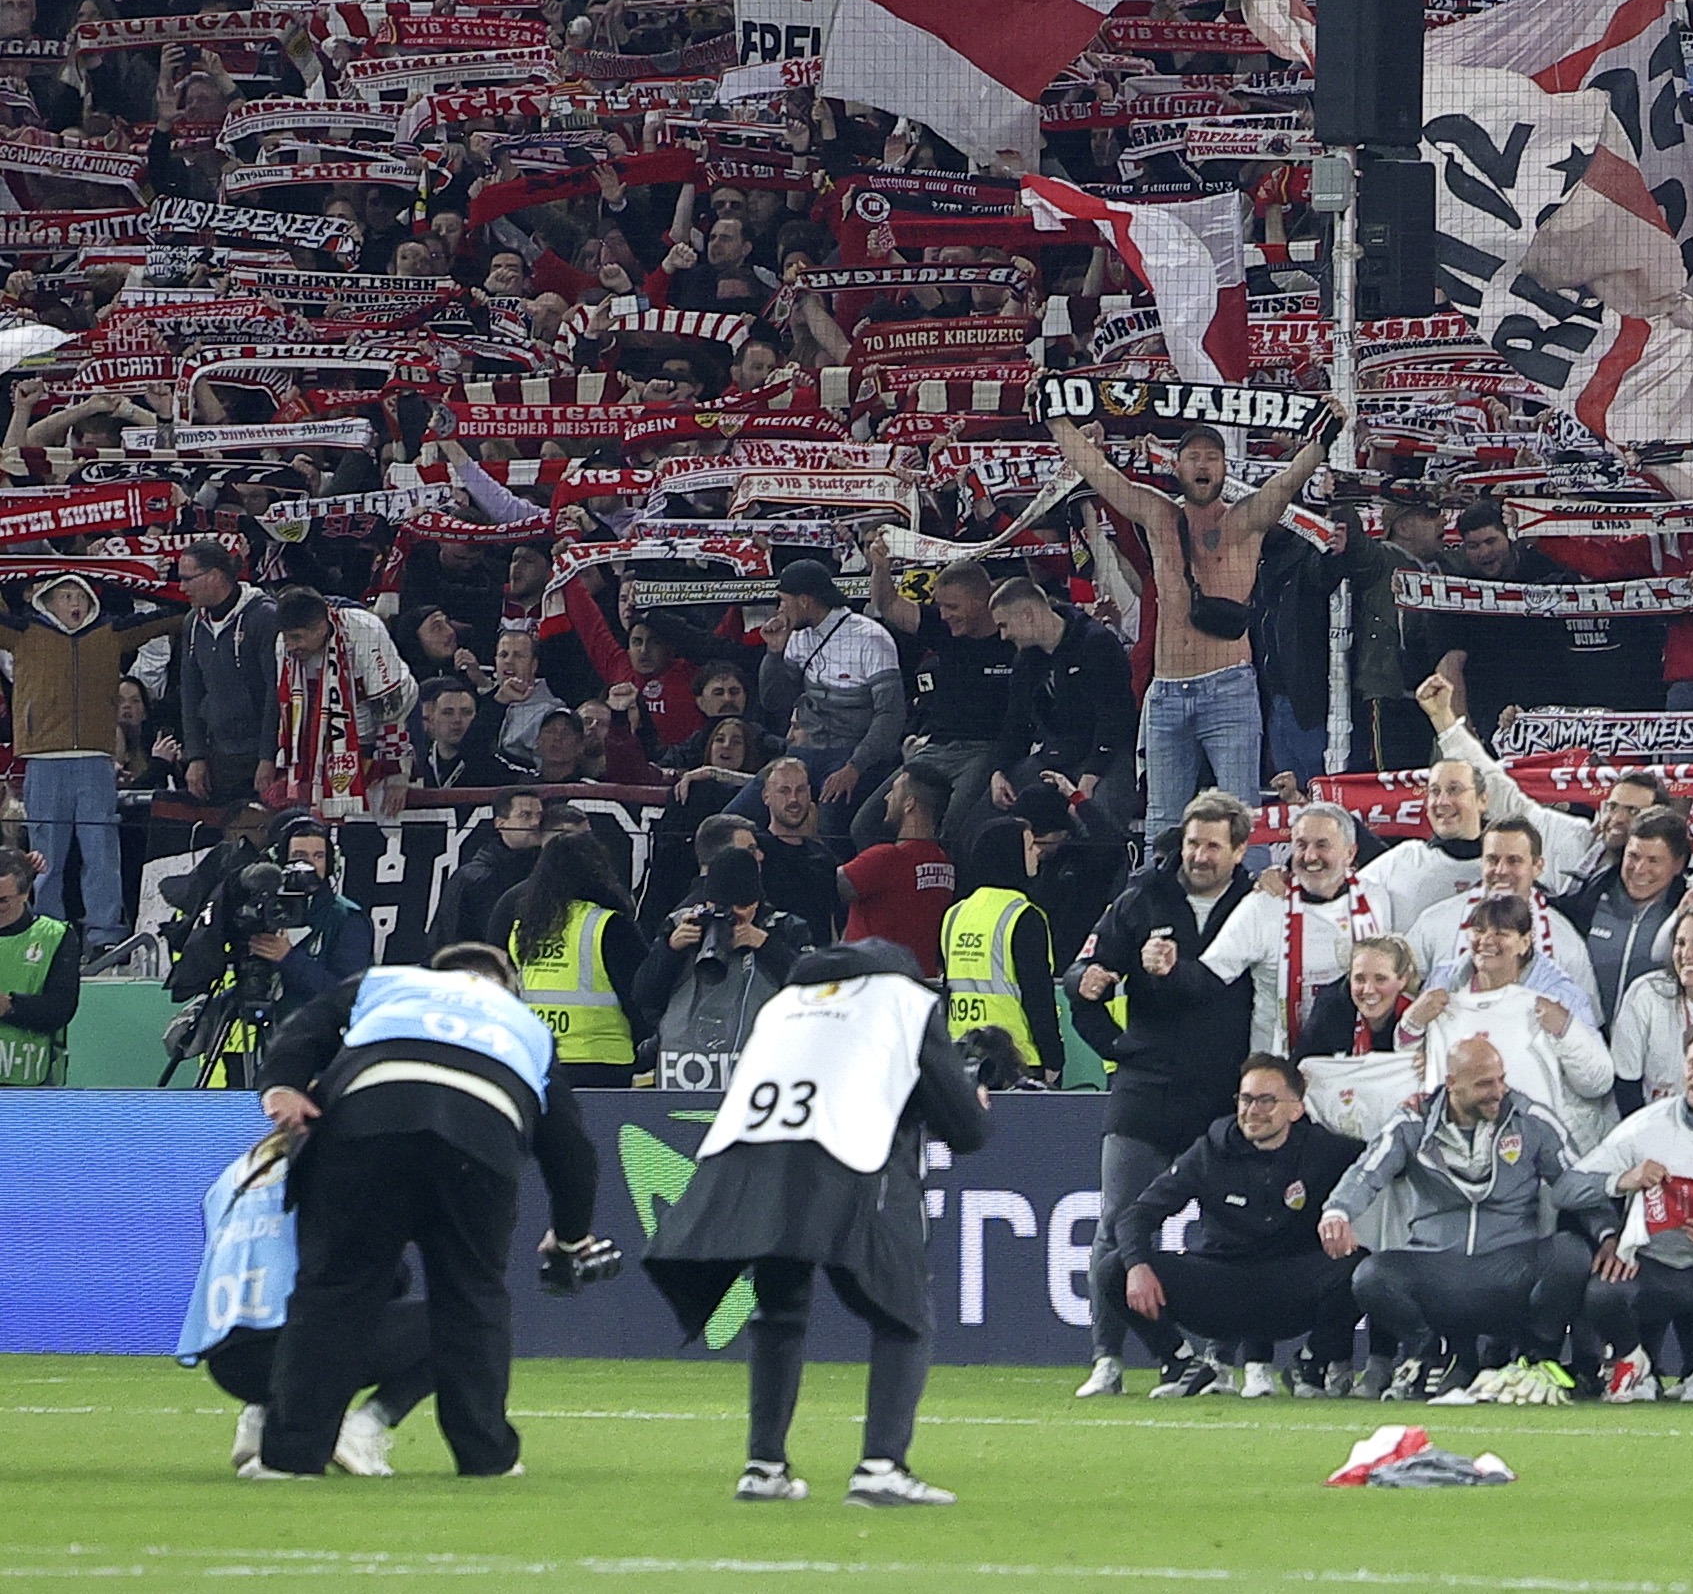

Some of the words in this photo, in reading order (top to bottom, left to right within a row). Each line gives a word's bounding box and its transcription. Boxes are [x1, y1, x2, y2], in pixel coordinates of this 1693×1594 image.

[76, 12, 295, 39] STUTTGART
[0, 147, 138, 178] SCHWABENJUNGE
[862, 336, 884, 352] 70
[888, 333, 938, 350] JAHRE
[469, 404, 647, 422] STUTTGART
[1044, 378, 1092, 417] 10
[1153, 383, 1308, 431] JAHRE
[458, 422, 538, 437] DEUTSCHER
[542, 422, 620, 436] MEISTER
[752, 415, 800, 430] MEINE
[806, 476, 874, 490] Stuttgart
[60, 498, 126, 527] KURVE
[1397, 572, 1693, 613] ULTRAS
[1551, 716, 1633, 749] IMMER
[955, 931, 985, 950] SDS
[949, 997, 988, 1024] 0951
[746, 1078, 817, 1132] 93
